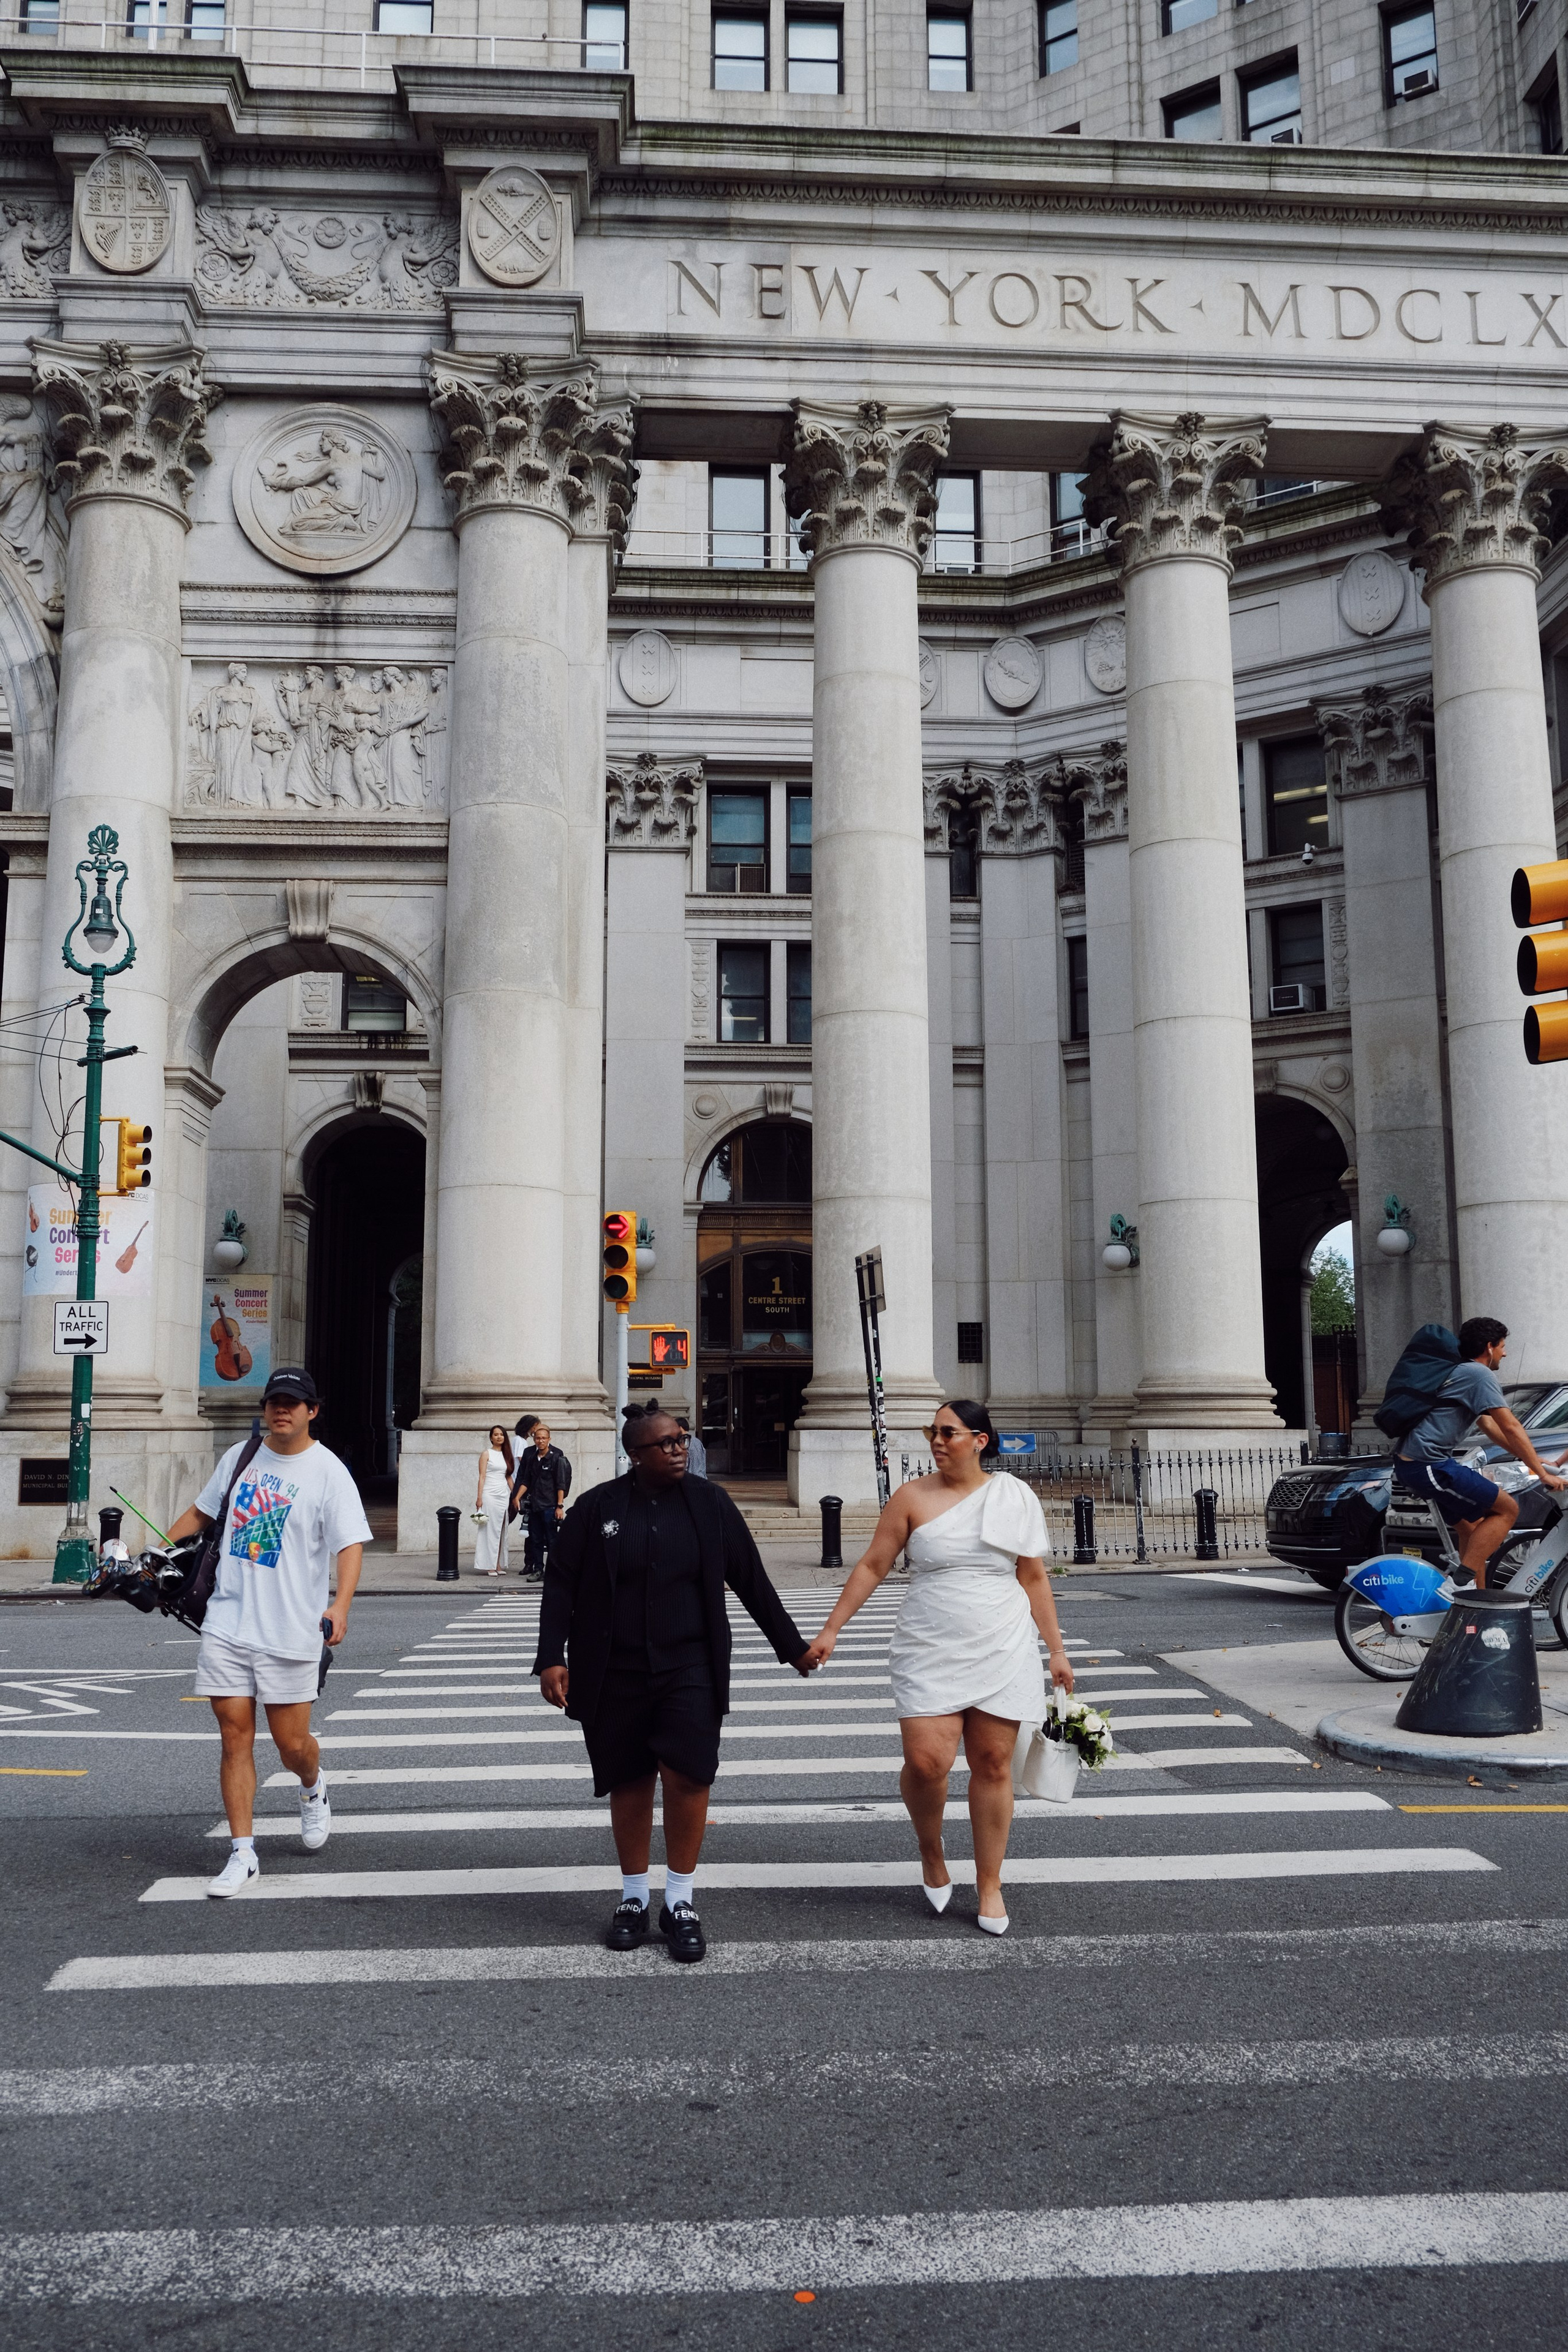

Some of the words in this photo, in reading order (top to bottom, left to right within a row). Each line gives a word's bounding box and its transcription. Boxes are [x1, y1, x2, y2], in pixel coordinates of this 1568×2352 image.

[668, 260, 872, 323] NEW
[918, 270, 1180, 334] YORK
[49, 1208, 112, 1225] Sumer
[49, 1227, 110, 1244] Conrt
[55, 1246, 101, 1263] Sers
[772, 1276, 783, 1294] 1
[234, 1289, 268, 1298] Summer
[235, 1298, 268, 1308] Concert
[67, 1306, 96, 1318] ALL
[242, 1308, 267, 1317] Series
[59, 1321, 103, 1332] TRAFFIC
[677, 1340, 687, 1360] 4
[260, 1473, 284, 1493] OPEN
[1534, 1559, 1554, 1579] bike
[1363, 1574, 1380, 1586] citi
[1381, 1574, 1404, 1585] bike
[616, 1904, 641, 1913] FENDI
[675, 1910, 699, 1921] FENDI
